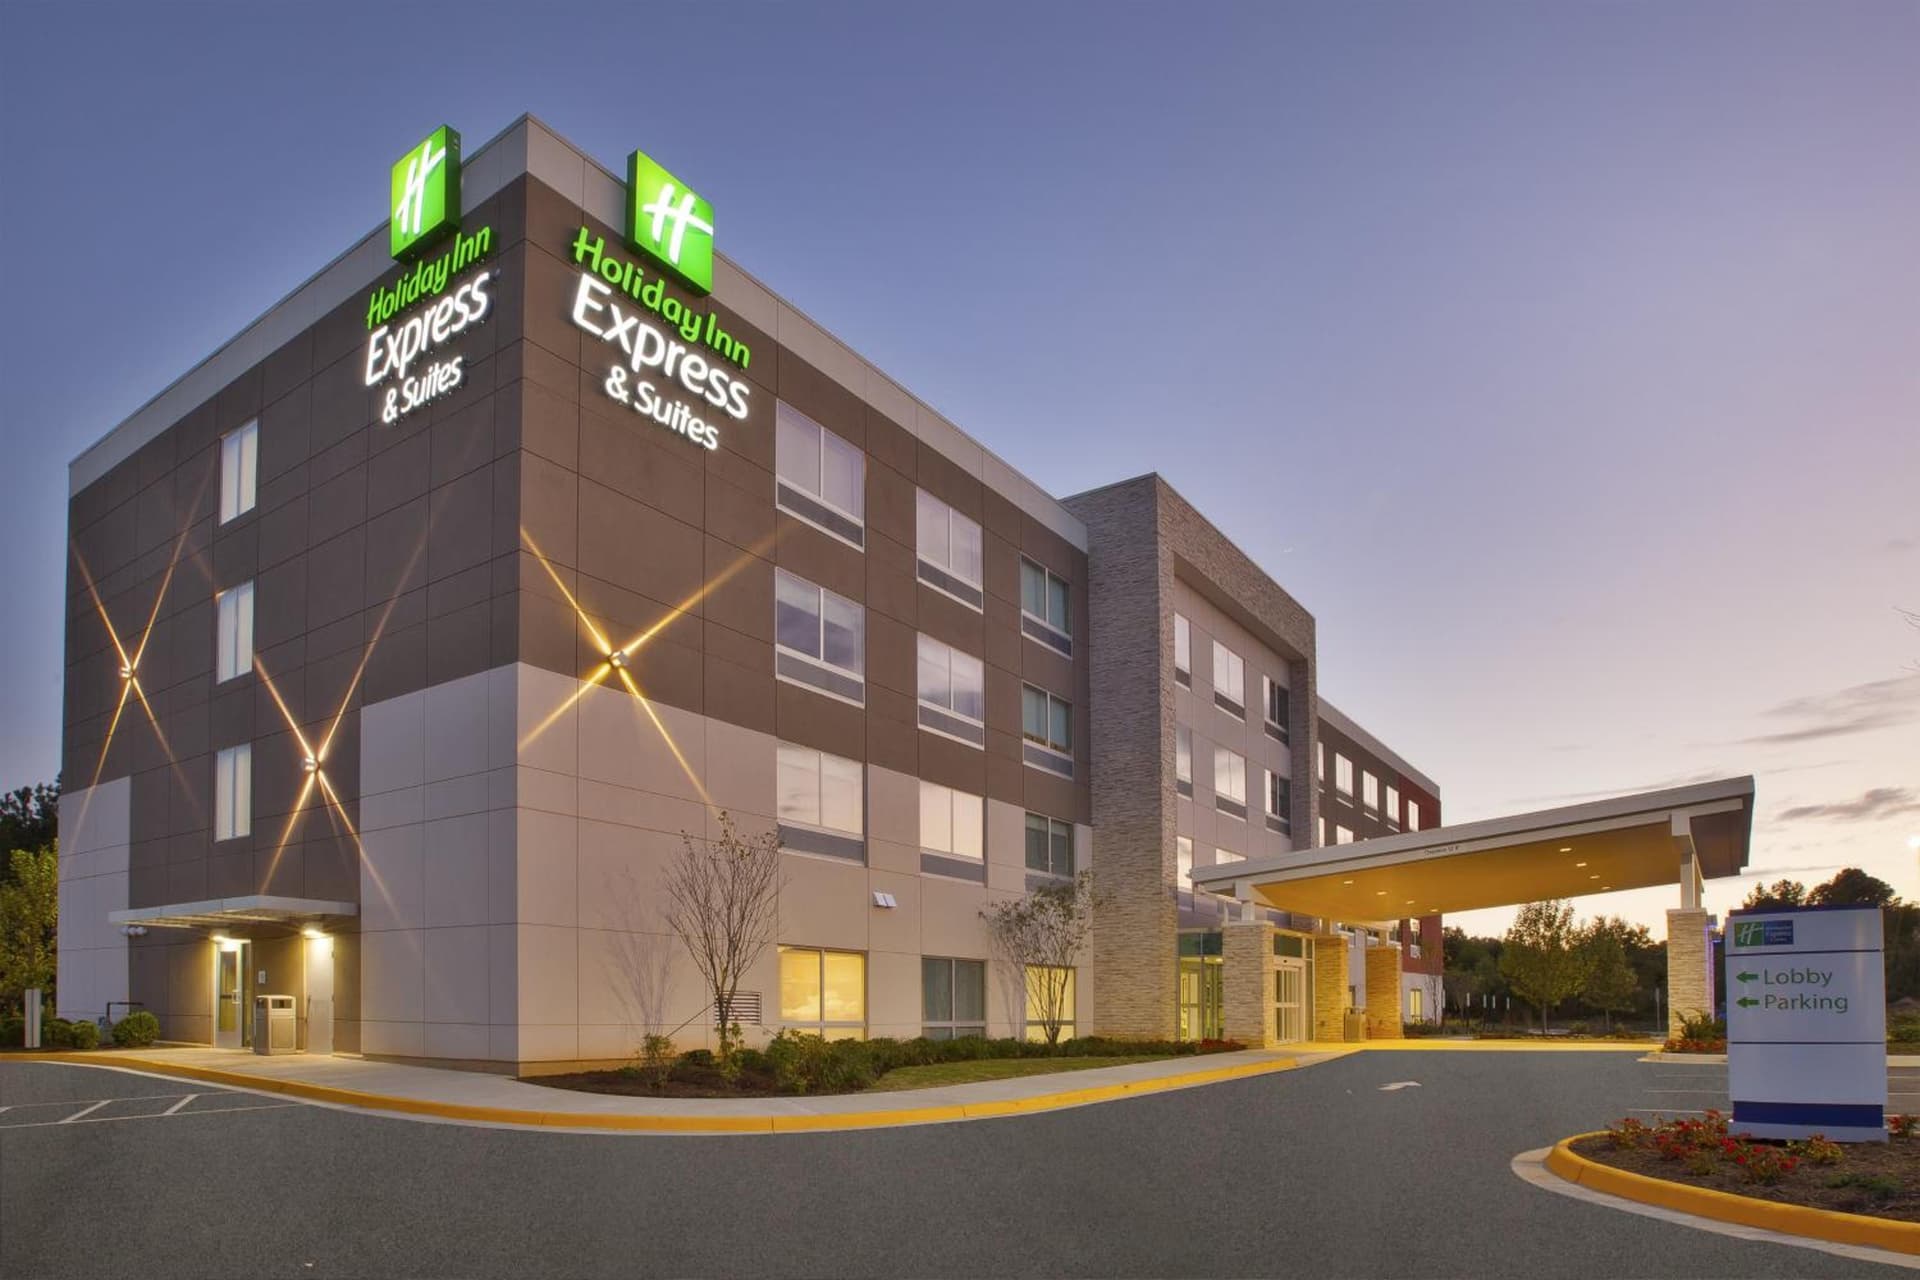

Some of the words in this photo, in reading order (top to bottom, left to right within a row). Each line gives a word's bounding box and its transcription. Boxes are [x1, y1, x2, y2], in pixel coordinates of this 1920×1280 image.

[367, 253, 449, 329] Holiday
[452, 226, 490, 273] Inn
[573, 226, 701, 342] Holiday
[706, 313, 750, 369] Inn
[365, 272, 489, 386] Express
[572, 273, 750, 419] Express
[382, 387, 398, 424] &
[400, 356, 463, 414] Suites
[605, 365, 628, 403] &
[634, 380, 719, 450] Suites
[1764, 968, 1833, 988] Lobby
[1764, 993, 1848, 1014] Parking
